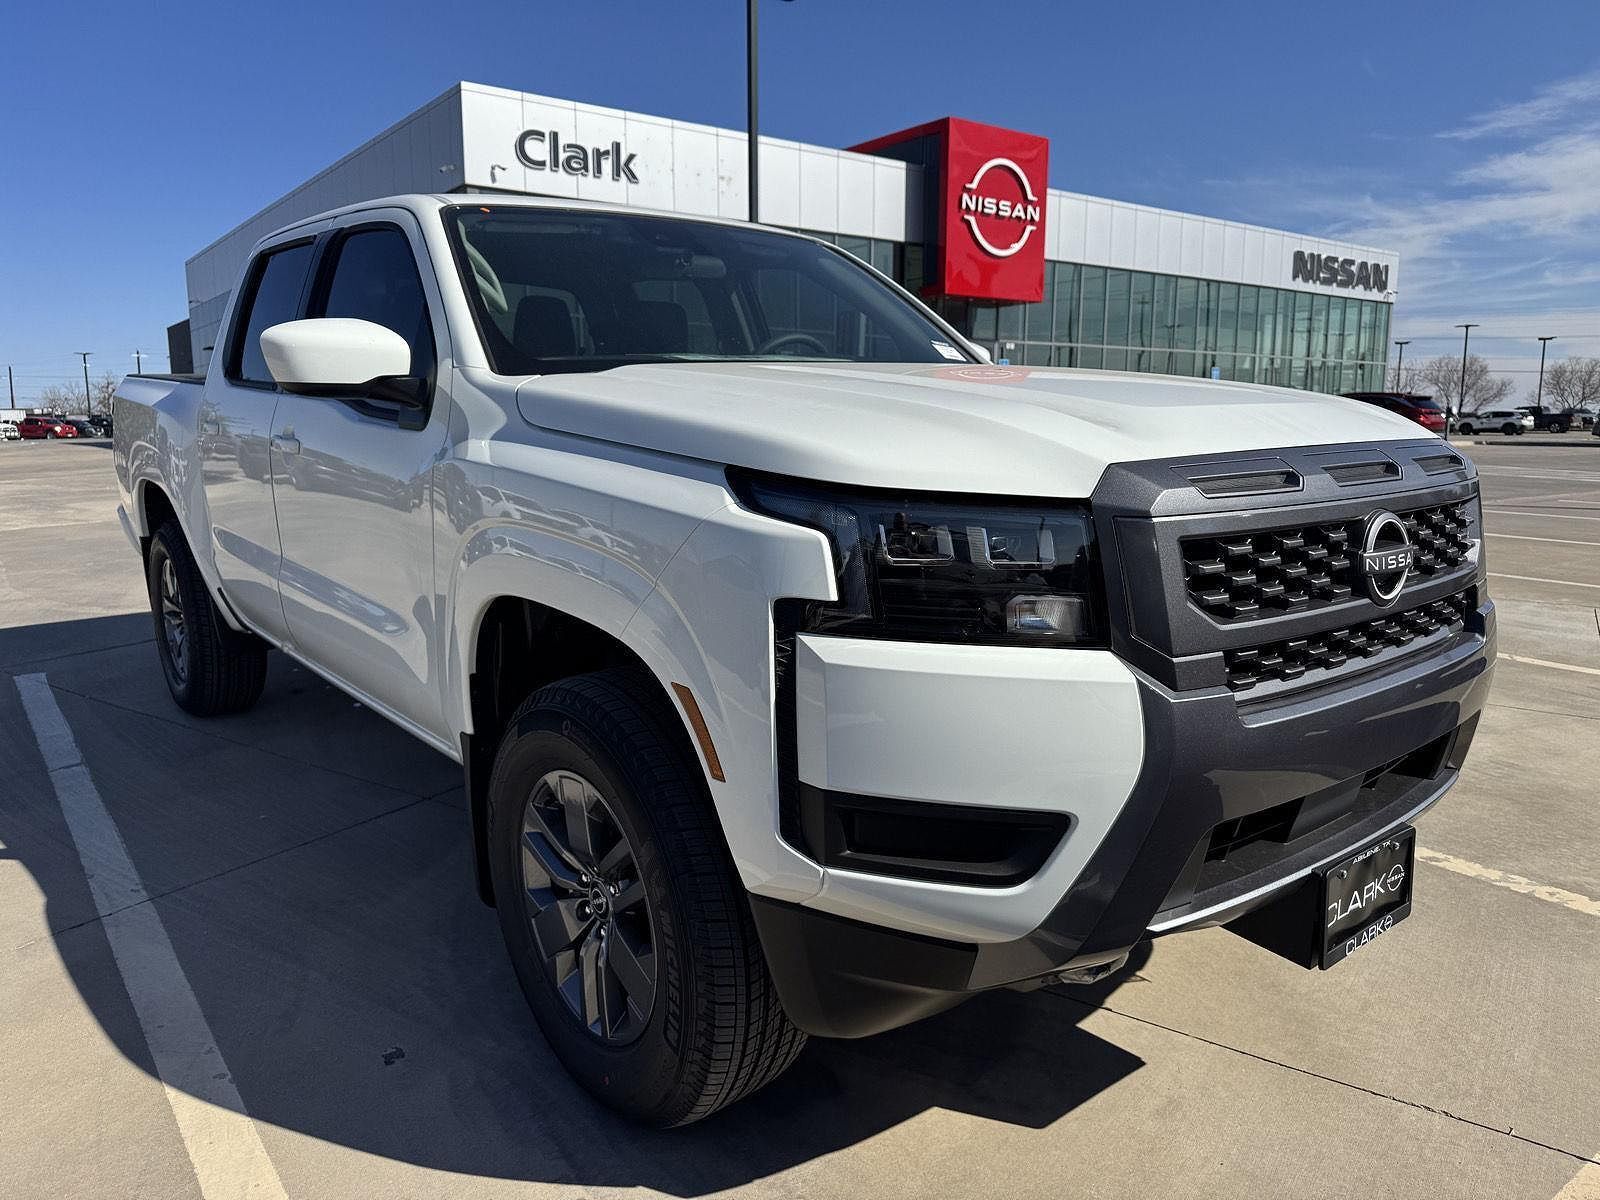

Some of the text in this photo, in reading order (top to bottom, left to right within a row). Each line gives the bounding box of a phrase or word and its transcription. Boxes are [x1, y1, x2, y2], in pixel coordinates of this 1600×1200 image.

[515, 129, 639, 184] Clark
[961, 192, 1040, 222] NISSAN
[1292, 250, 1389, 293] NISSAN
[1366, 552, 1412, 571] NISSA
[1327, 873, 1386, 928] CLARK
[1345, 919, 1384, 955] CLARK
